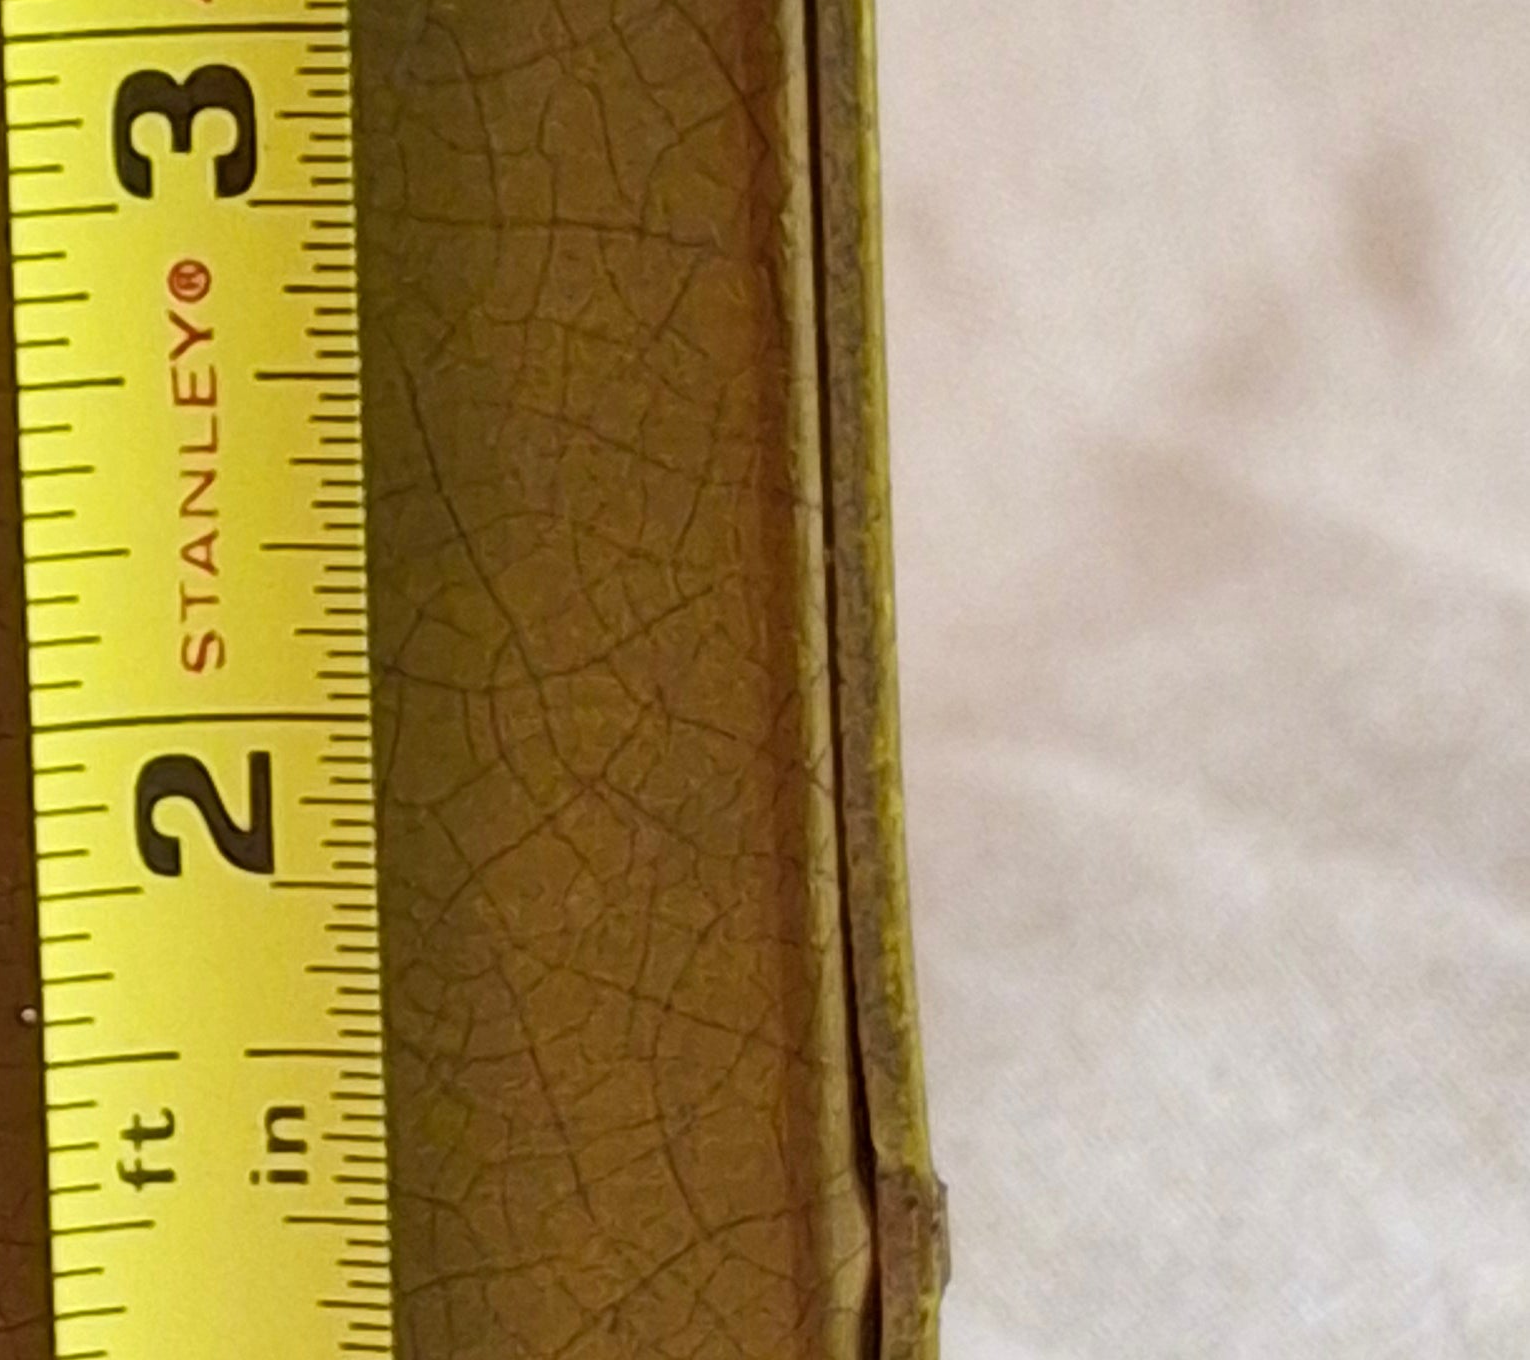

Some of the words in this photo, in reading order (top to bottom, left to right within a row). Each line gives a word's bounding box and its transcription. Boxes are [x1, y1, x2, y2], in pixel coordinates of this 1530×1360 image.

[112, 64, 257, 199] 3
[134, 750, 276, 878] 2
[117, 1106, 177, 1192] ft
[248, 1105, 309, 1186] in
